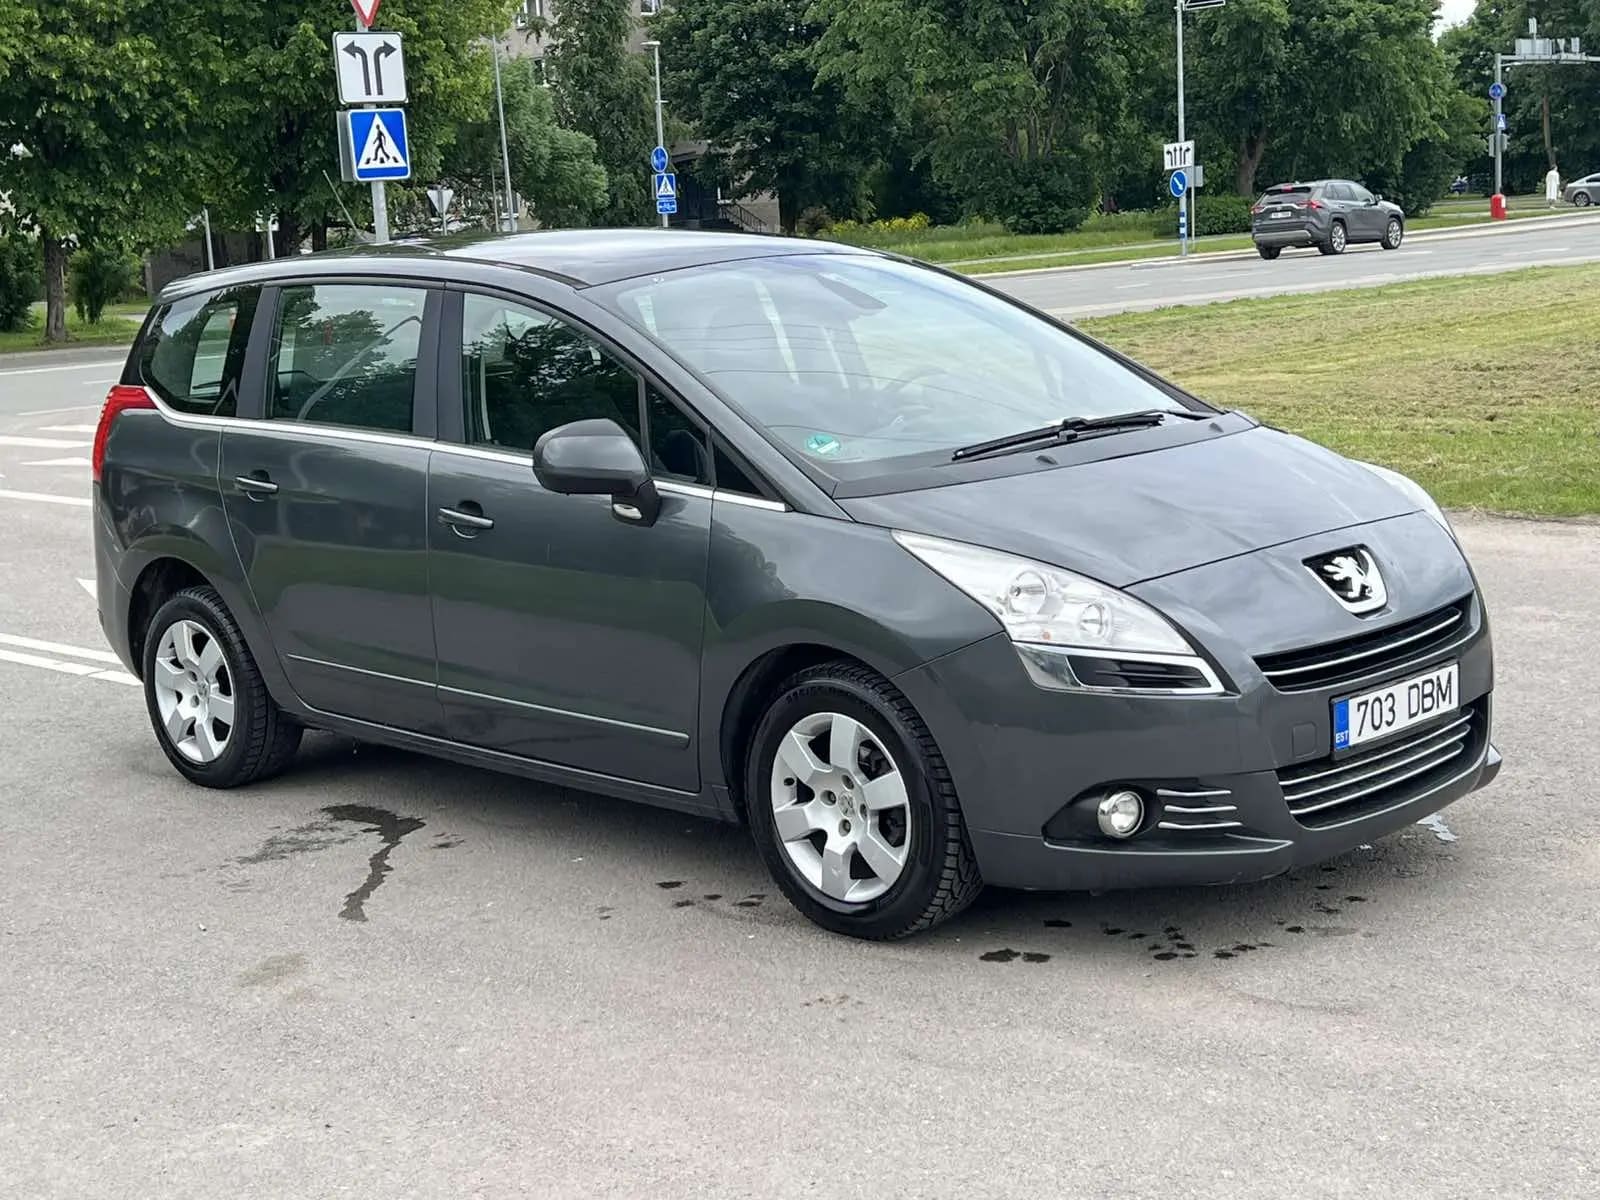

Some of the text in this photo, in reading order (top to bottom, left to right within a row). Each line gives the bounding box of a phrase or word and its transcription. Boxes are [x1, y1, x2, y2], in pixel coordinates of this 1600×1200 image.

[1357, 671, 1452, 737] 703 DBM
[1335, 730, 1349, 743] EST
